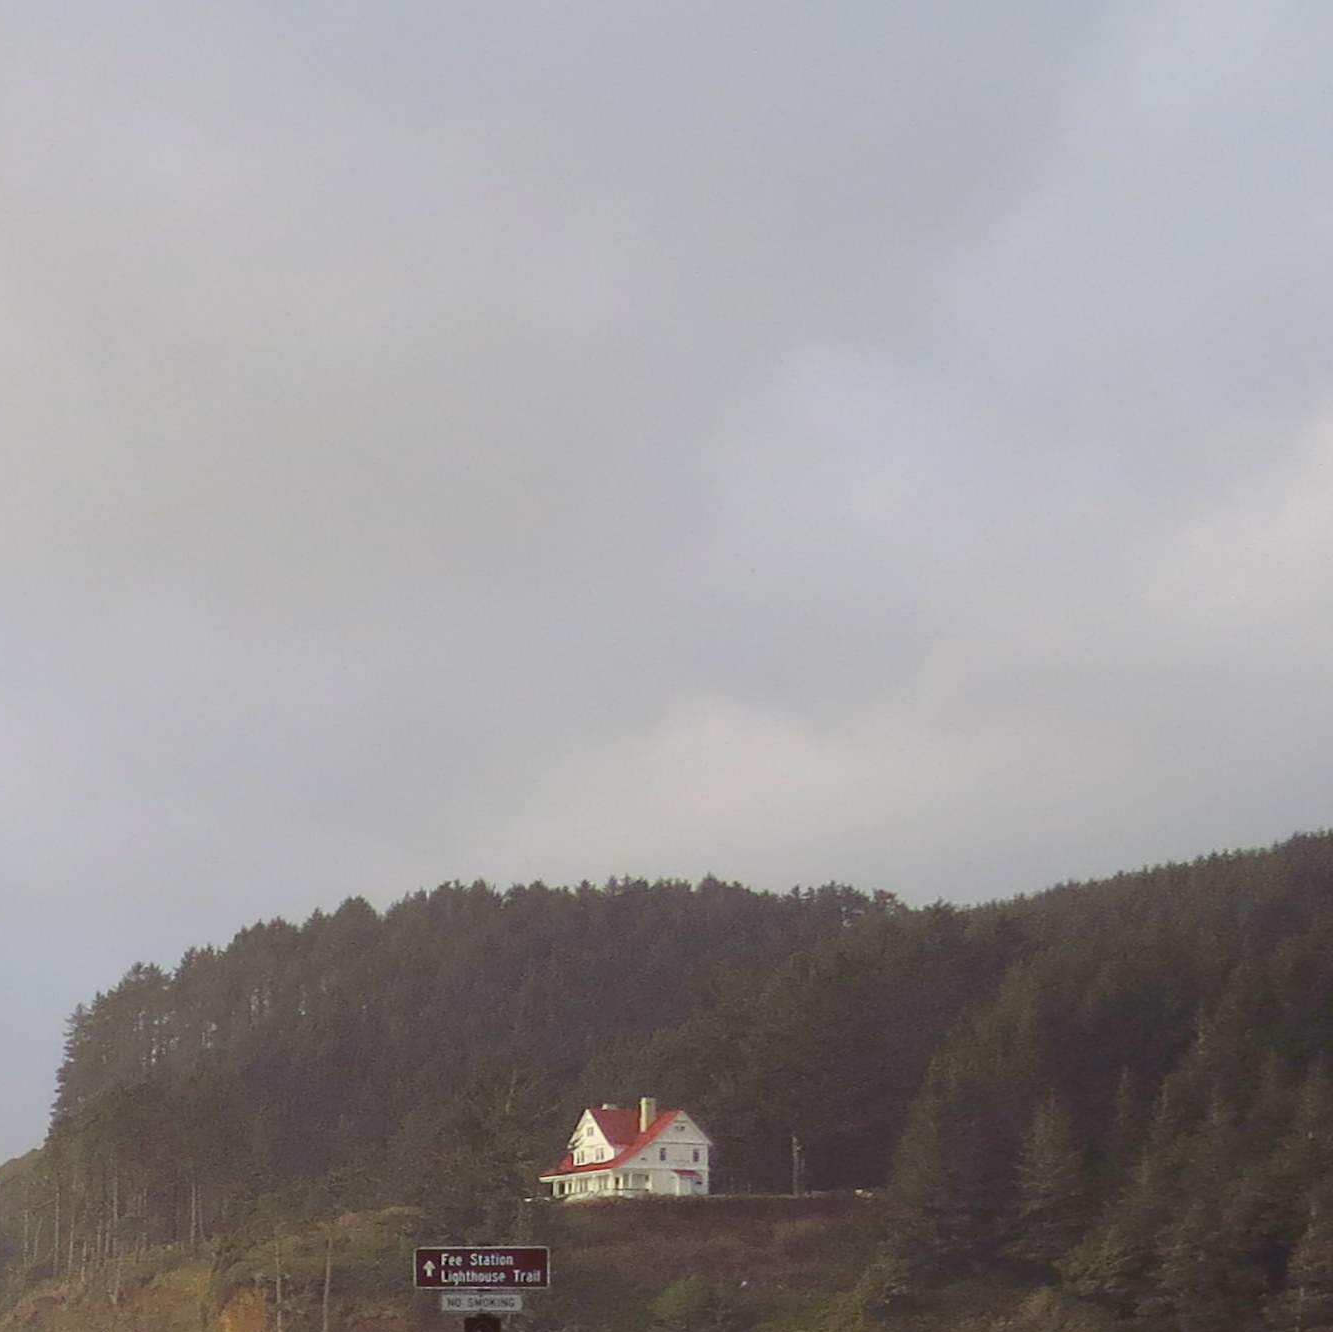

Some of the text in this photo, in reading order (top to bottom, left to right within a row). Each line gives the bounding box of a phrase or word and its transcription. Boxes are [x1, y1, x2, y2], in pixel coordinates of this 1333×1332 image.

[441, 1253, 514, 1266] Fee Station
[441, 1269, 541, 1285] Lighthouse Trail
[447, 1297, 515, 1308] NO SMOKING
